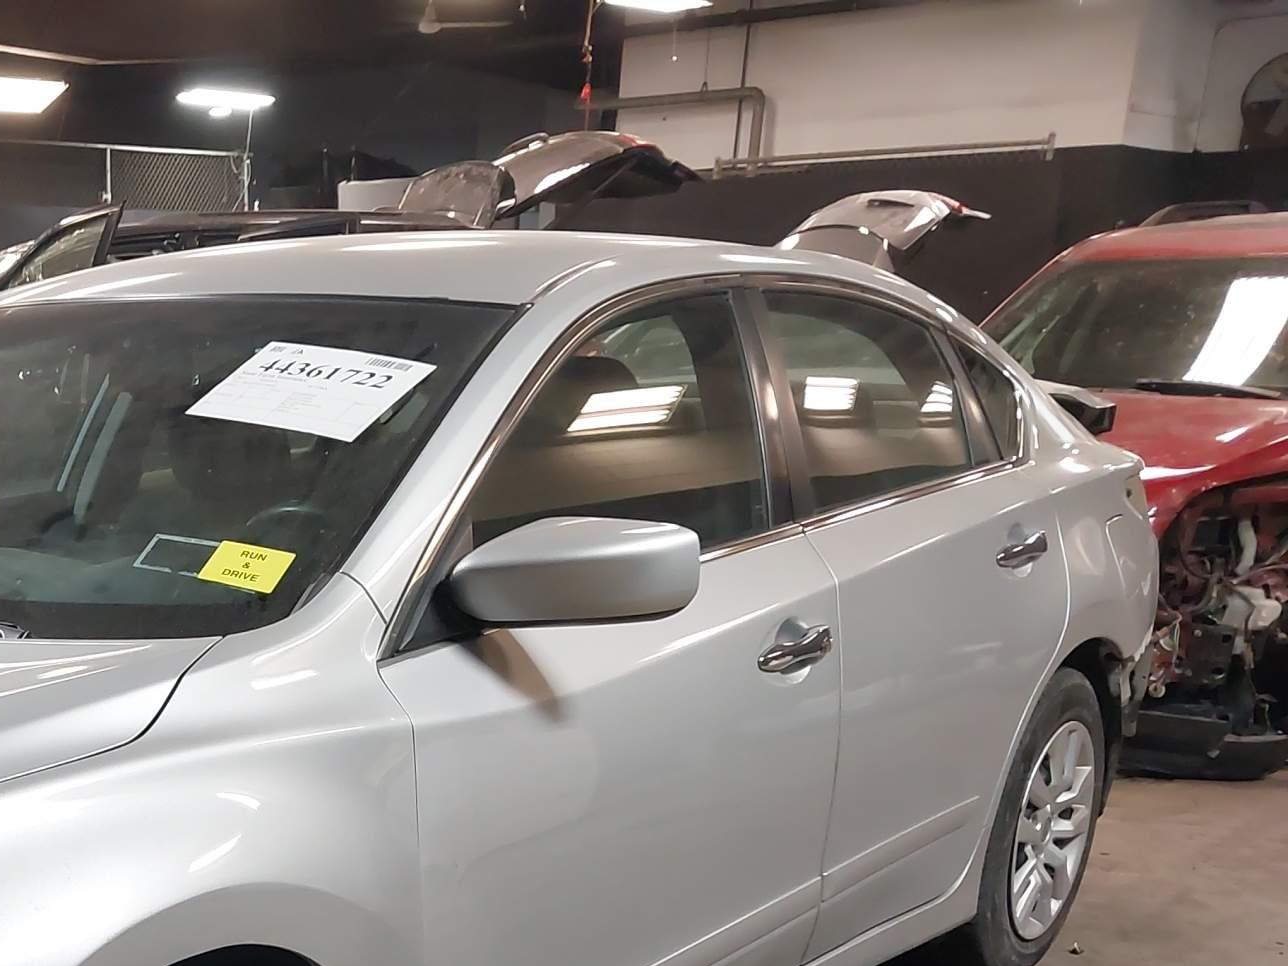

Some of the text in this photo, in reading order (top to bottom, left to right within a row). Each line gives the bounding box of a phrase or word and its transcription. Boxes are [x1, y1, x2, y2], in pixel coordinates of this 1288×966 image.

[259, 359, 393, 389] 44361722
[240, 550, 268, 561] RUN
[221, 568, 260, 582] DRIVE
